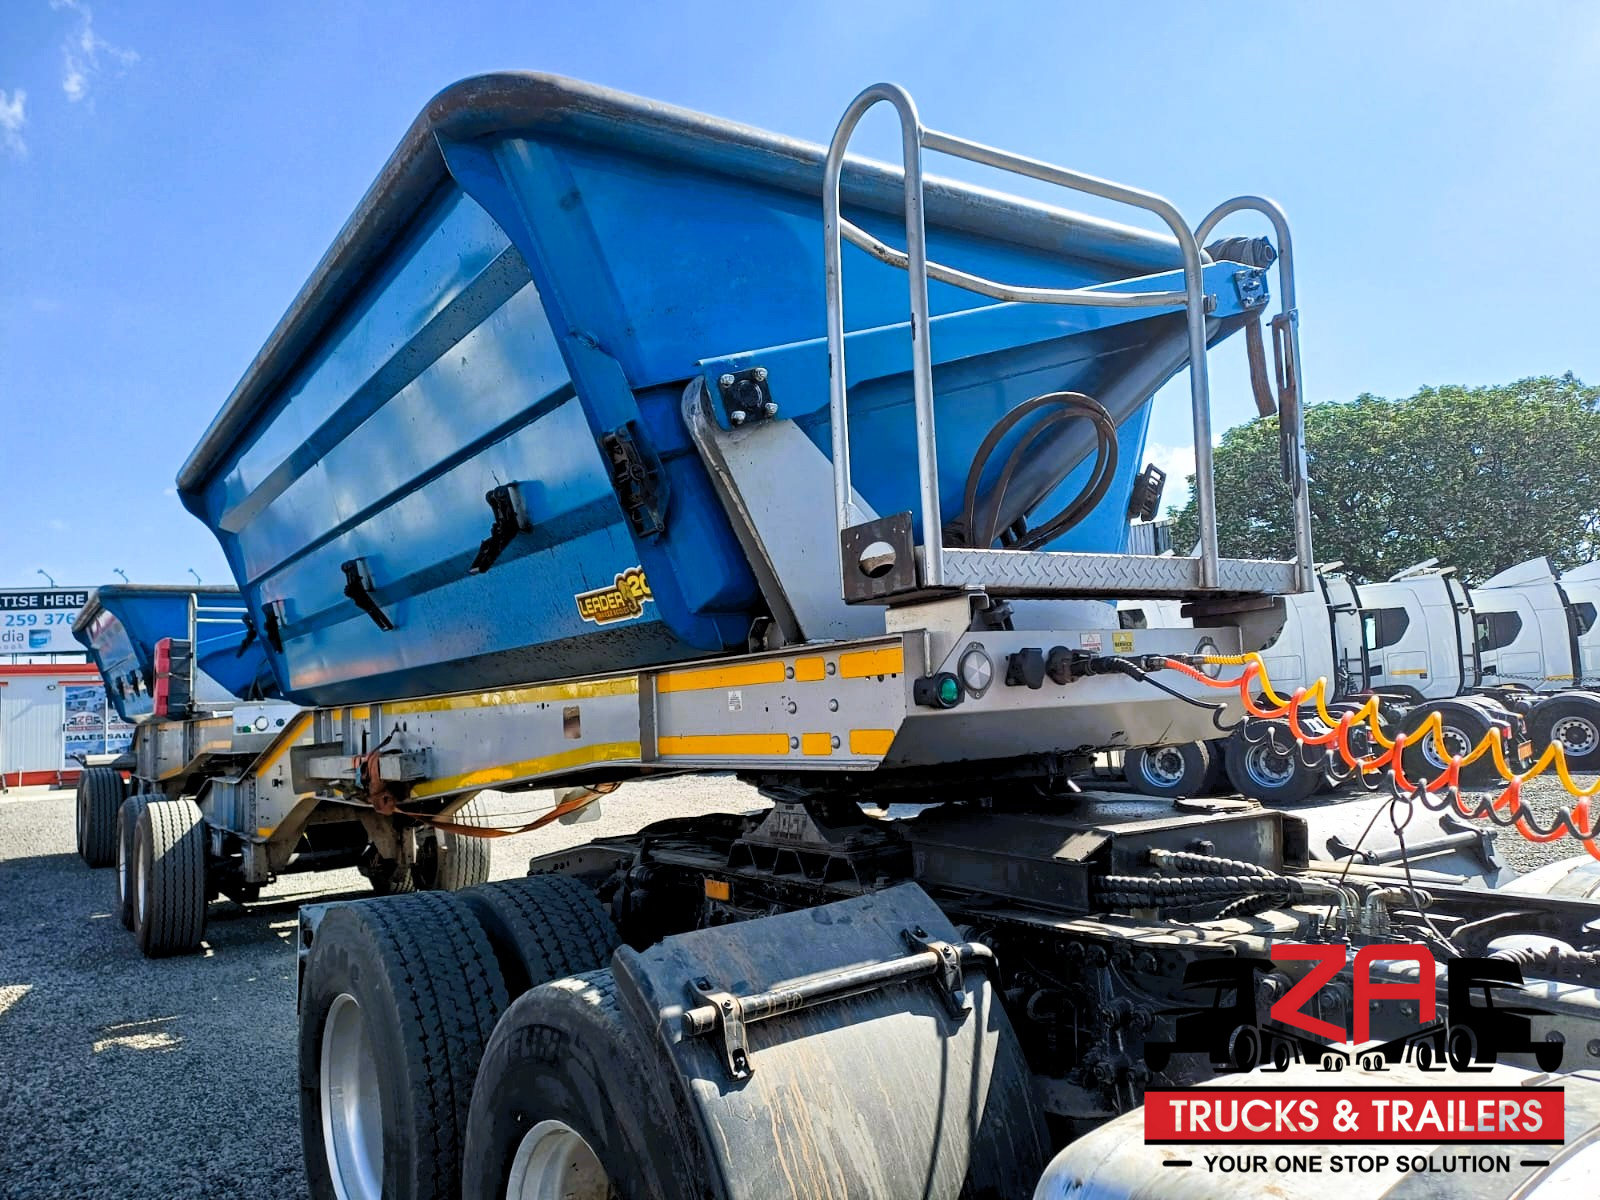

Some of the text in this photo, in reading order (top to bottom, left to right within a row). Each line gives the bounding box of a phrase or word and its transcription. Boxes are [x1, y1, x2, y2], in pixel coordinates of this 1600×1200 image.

[0, 594, 85, 608] TISE HERE
[580, 592, 625, 614] LEADER
[5, 612, 76, 627] 259 376
